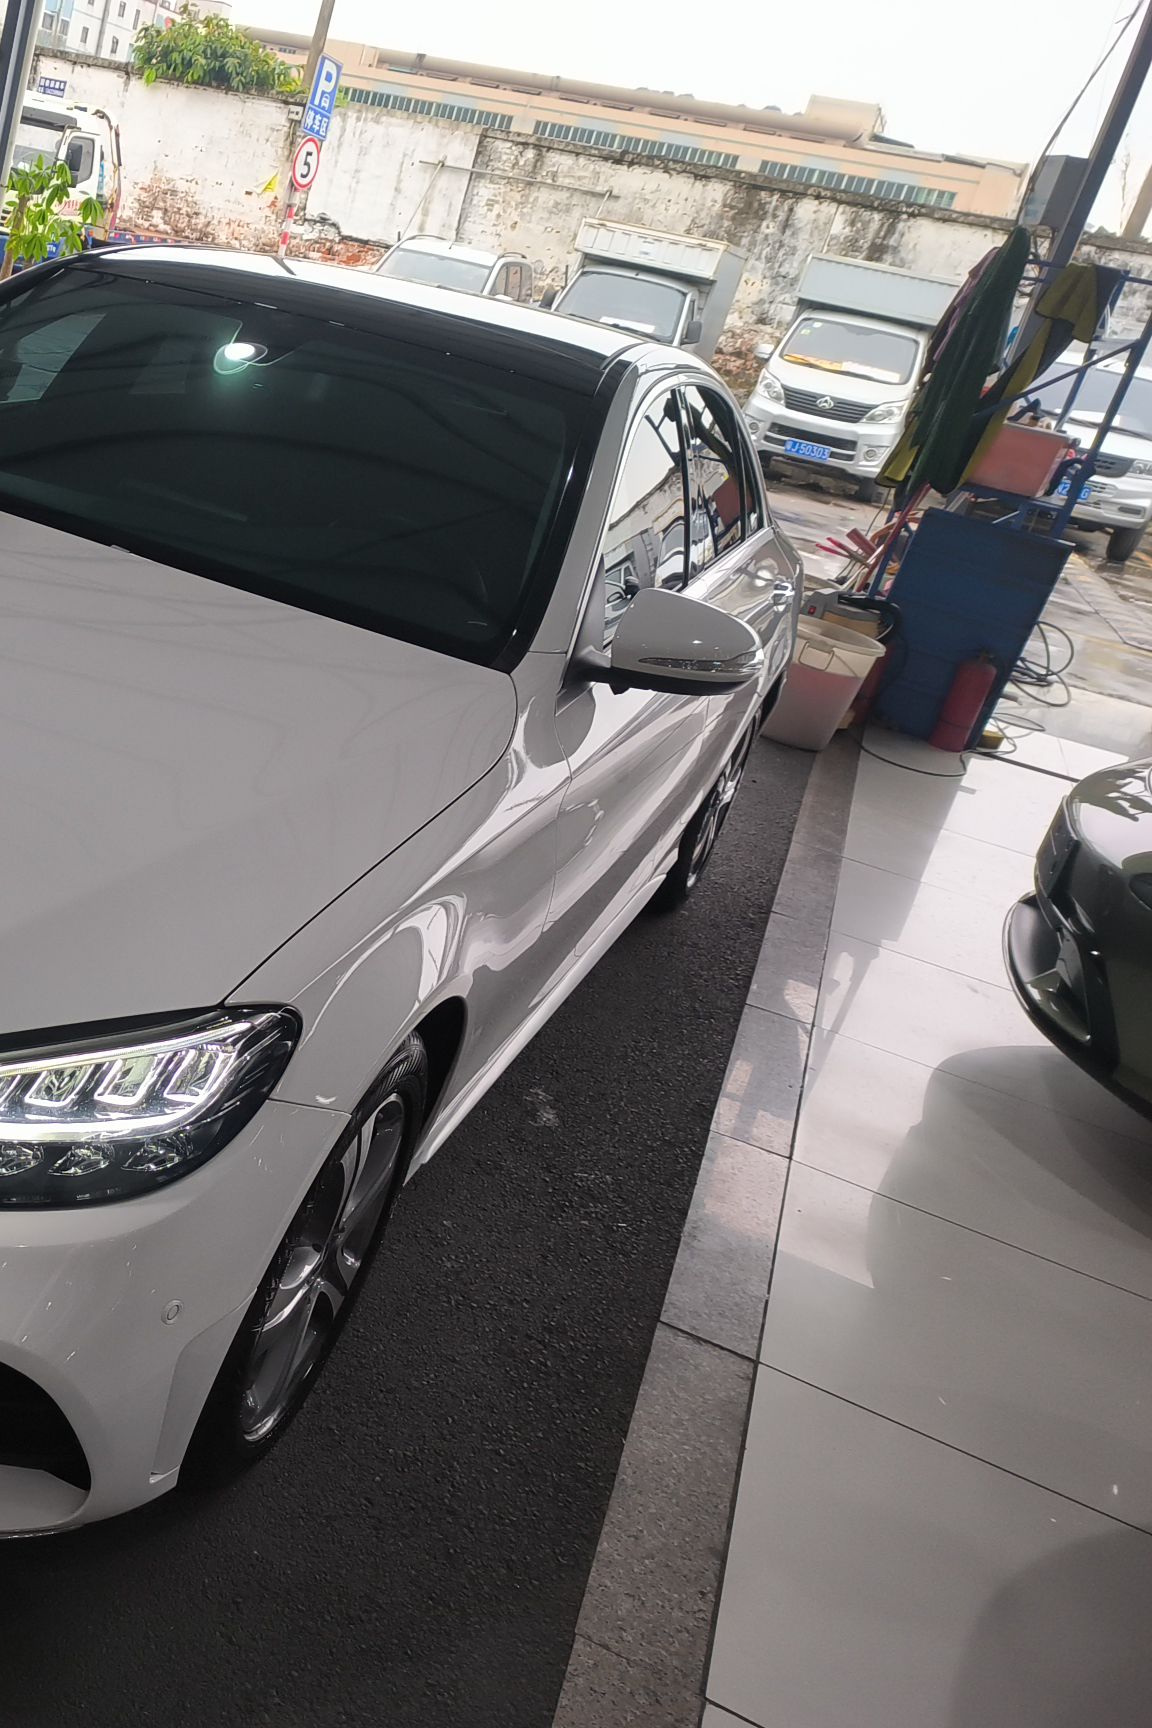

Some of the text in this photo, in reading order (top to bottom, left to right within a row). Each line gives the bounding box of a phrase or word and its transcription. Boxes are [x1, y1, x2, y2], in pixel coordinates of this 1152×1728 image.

[314, 59, 338, 106] P
[304, 109, 329, 136] 停车区
[300, 151, 313, 179] 5
